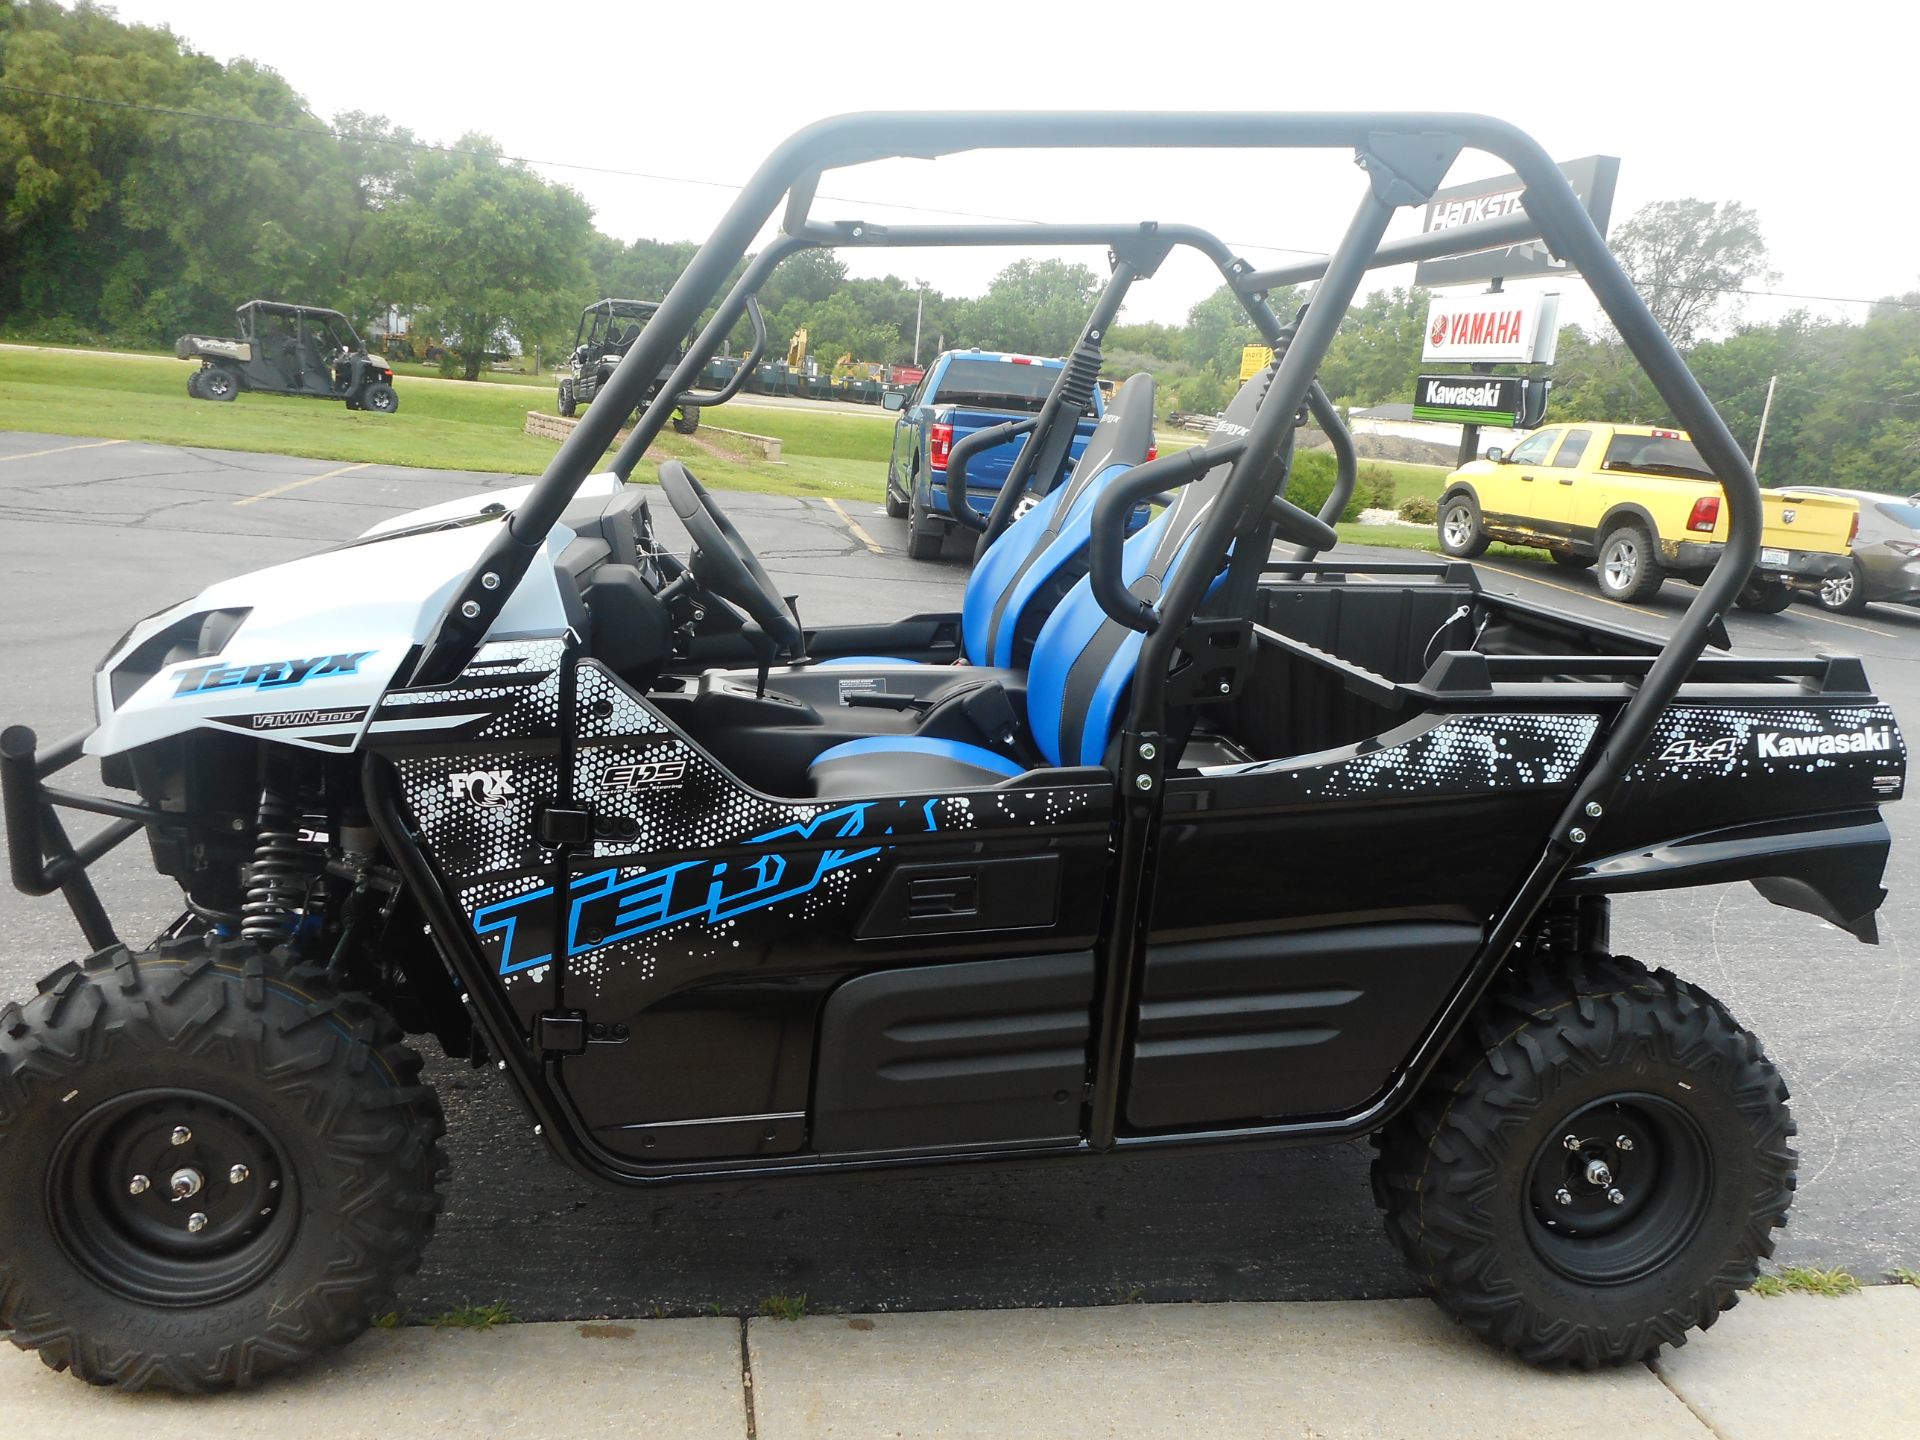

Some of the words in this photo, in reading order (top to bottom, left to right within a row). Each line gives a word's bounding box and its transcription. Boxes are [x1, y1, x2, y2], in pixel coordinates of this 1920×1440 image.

[1450, 310, 1522, 345] YAMAHA
[1426, 381, 1501, 407] Kawasaki
[1658, 737, 1736, 763] 4x4
[1757, 726, 1890, 758] Kawasaki
[449, 769, 516, 809] FOX
[601, 761, 687, 789] EPS
